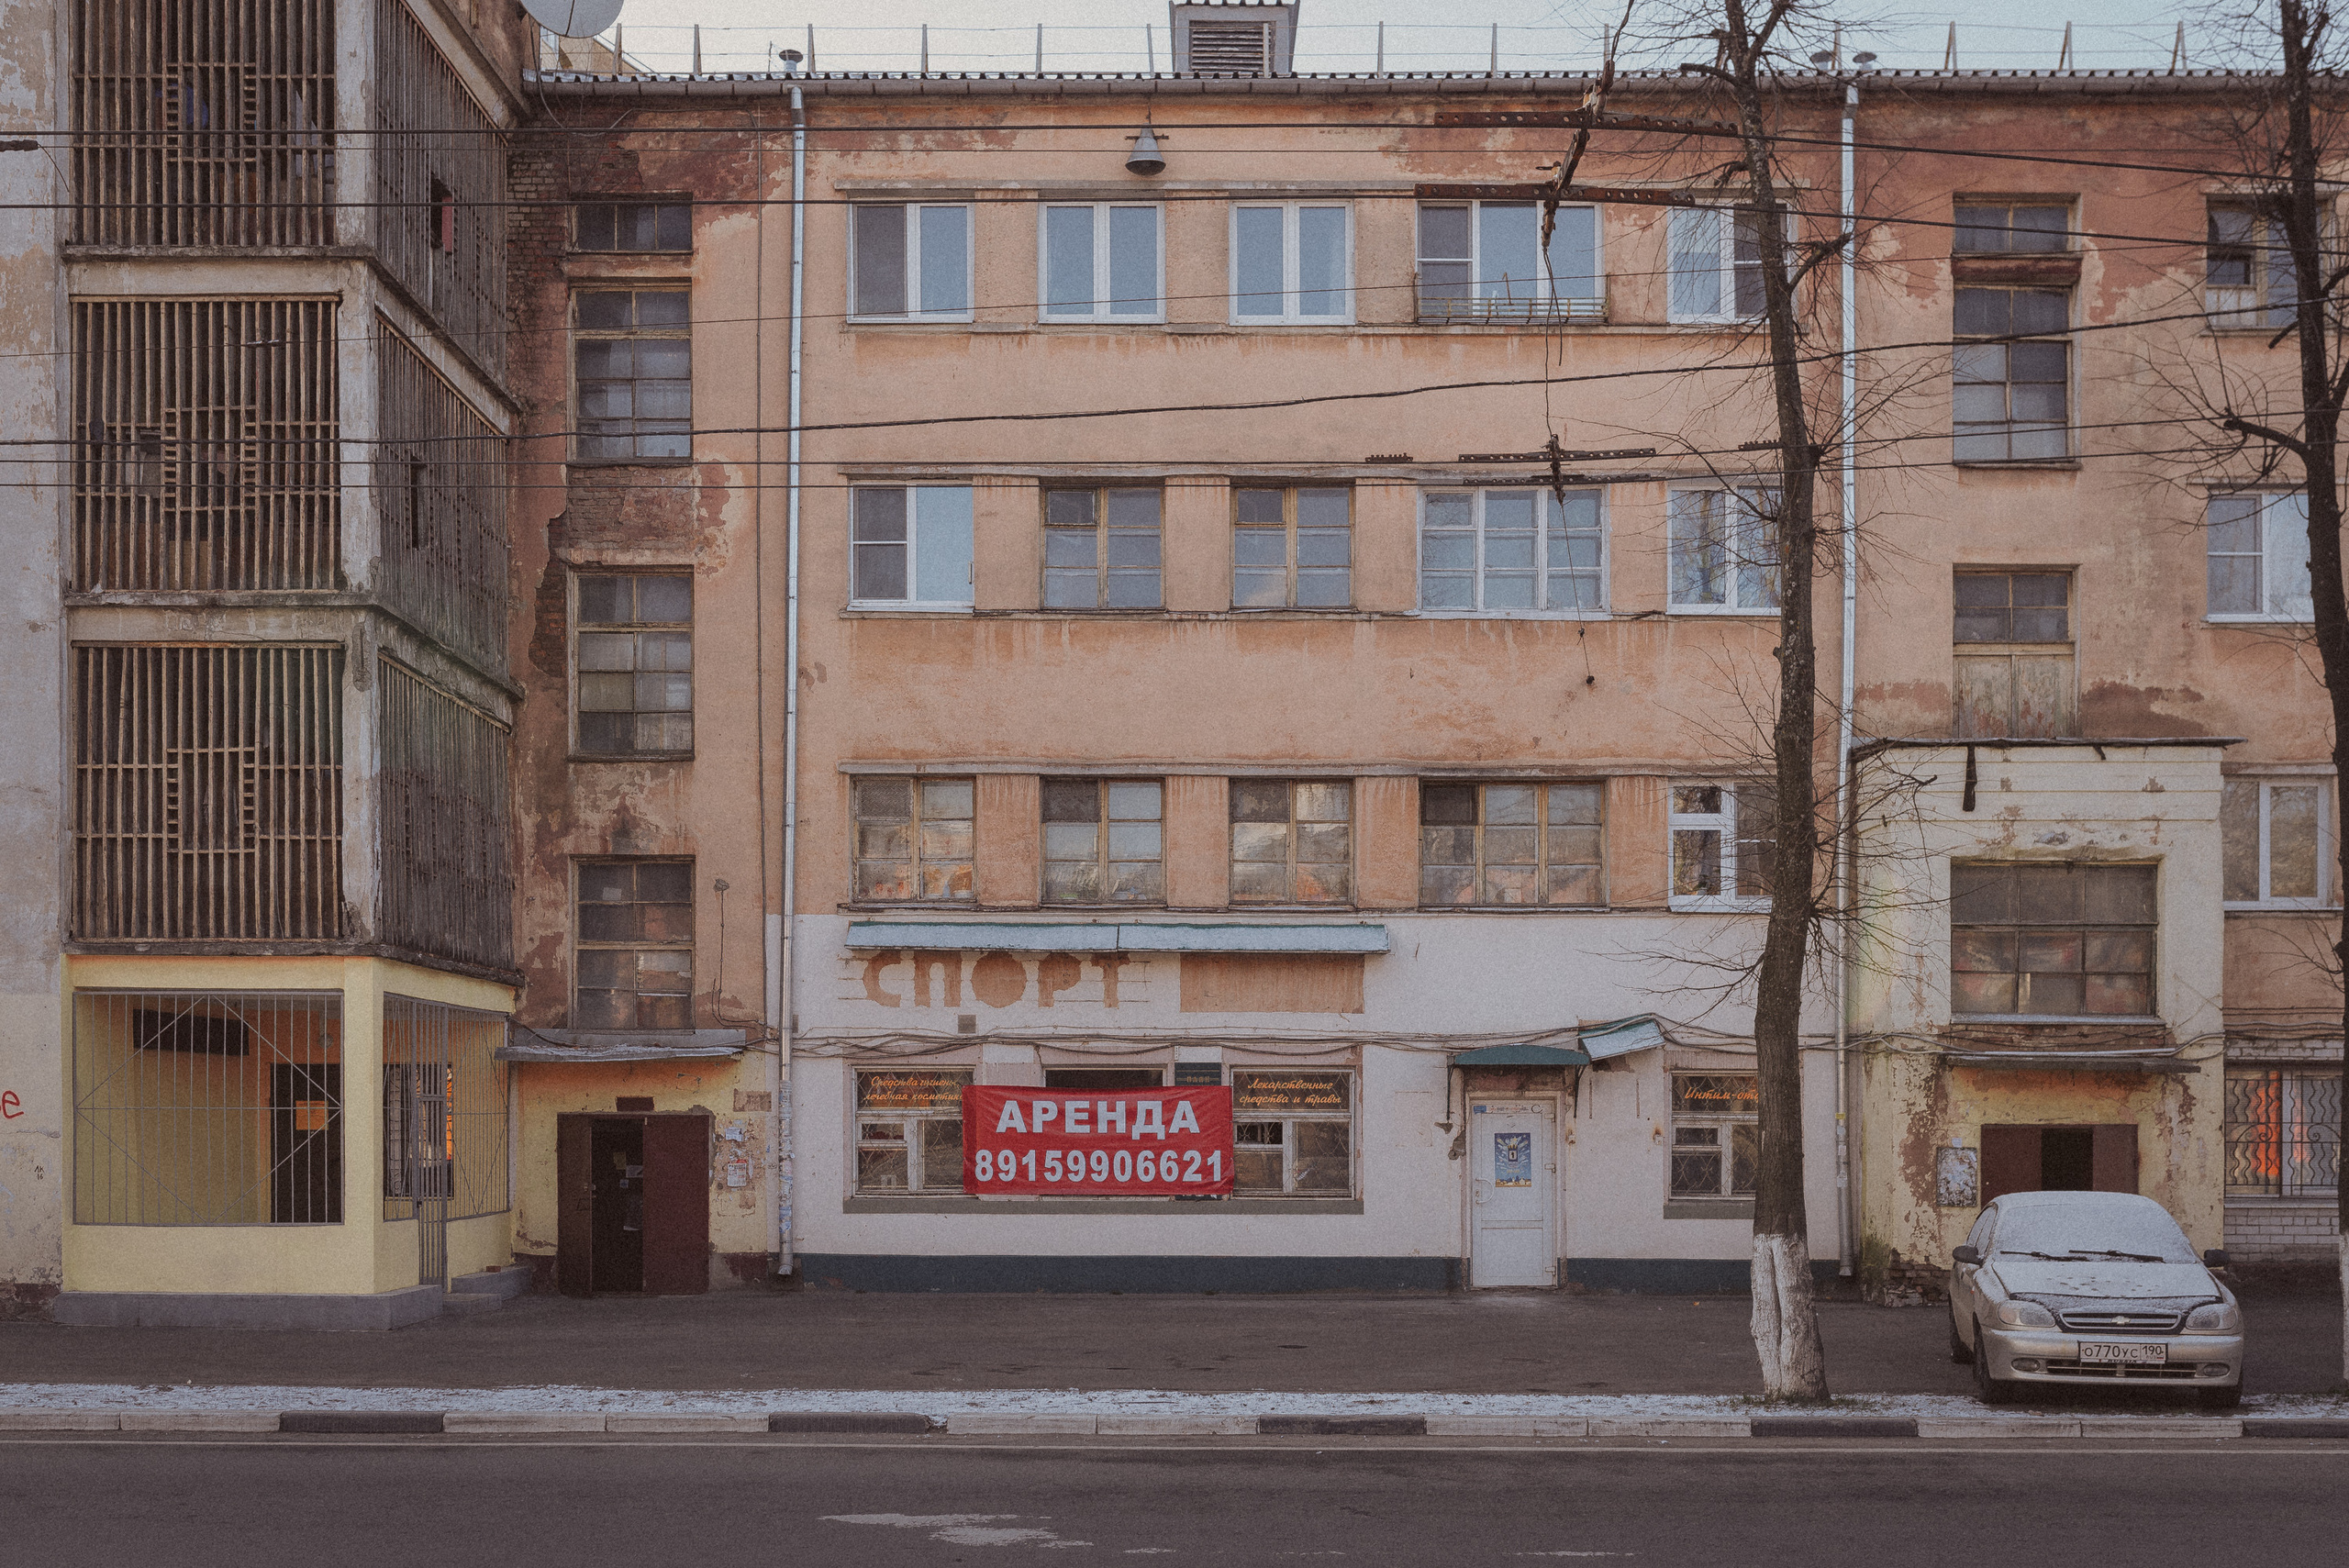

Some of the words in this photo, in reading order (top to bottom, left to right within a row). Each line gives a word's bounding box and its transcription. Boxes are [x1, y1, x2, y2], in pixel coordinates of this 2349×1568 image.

[863, 951, 1130, 1008] СПОРТ
[871, 1075, 918, 1088] Средства
[1248, 1078, 1333, 1091] Лекарственные
[1239, 1094, 1289, 1106] средства
[1304, 1095, 1341, 1106] травы
[996, 1101, 1200, 1140] АРЕНДА
[975, 1150, 1221, 1182] 89159906621
[2143, 1346, 2161, 1355] 190
